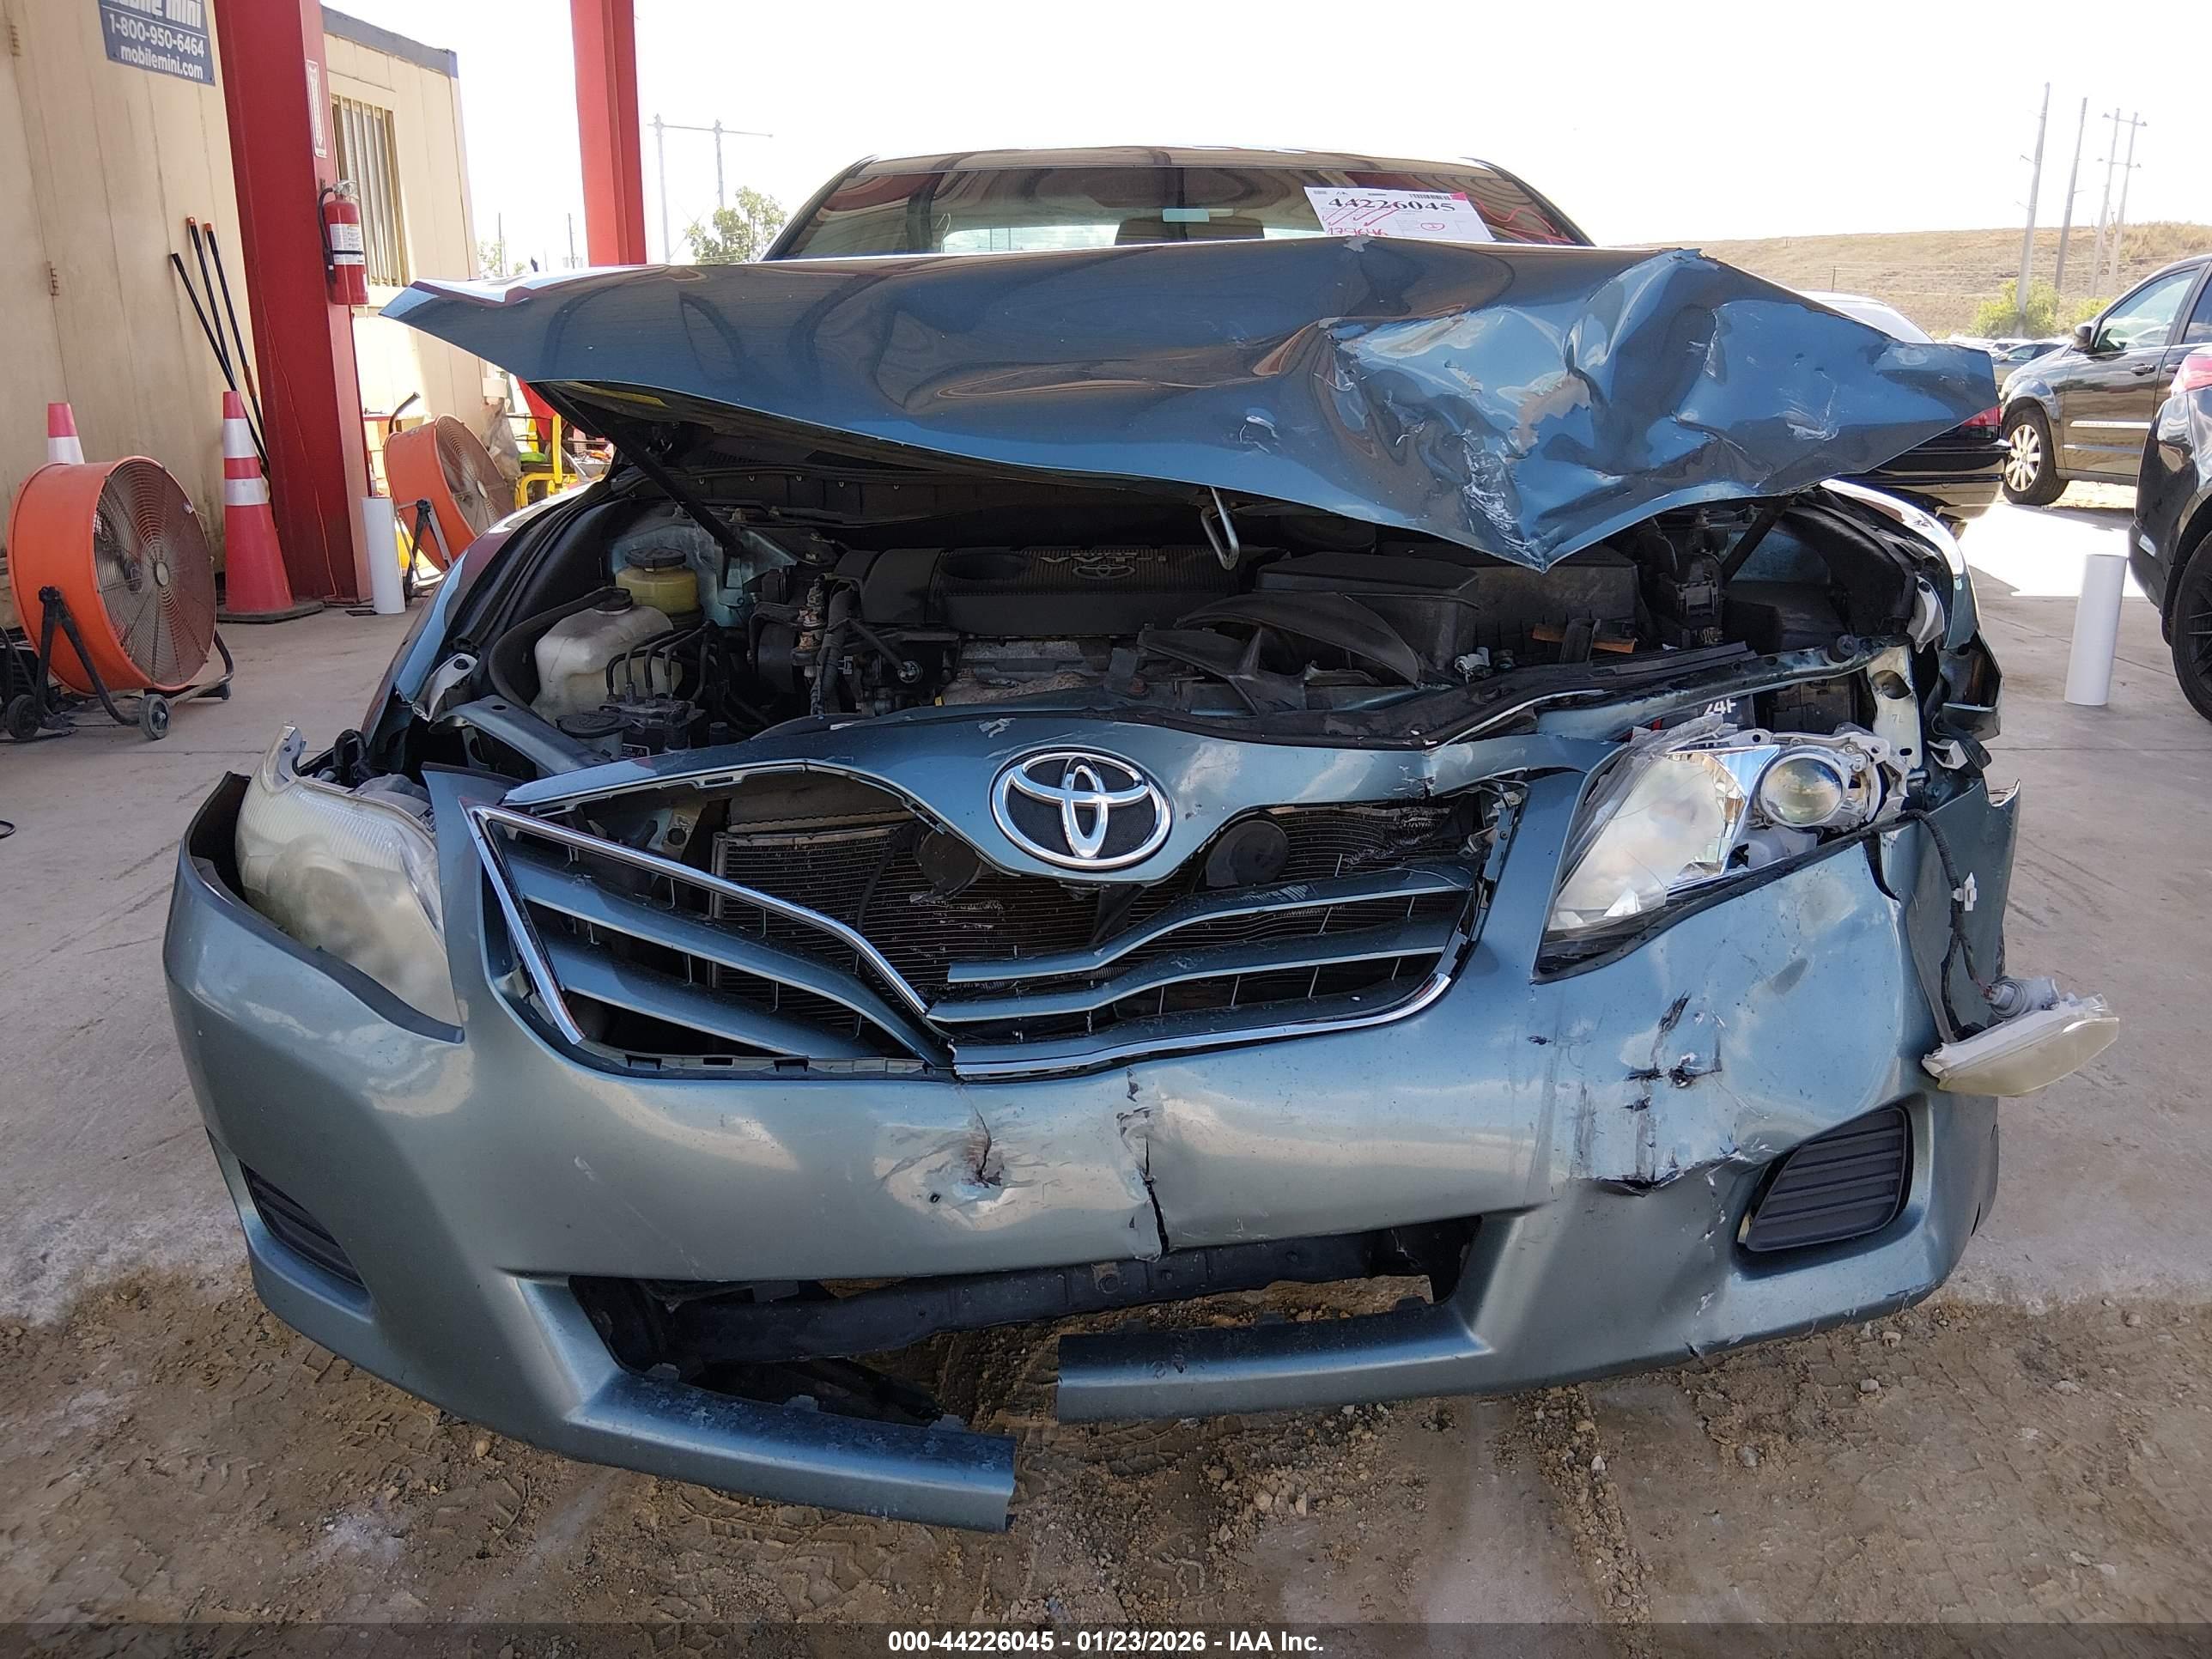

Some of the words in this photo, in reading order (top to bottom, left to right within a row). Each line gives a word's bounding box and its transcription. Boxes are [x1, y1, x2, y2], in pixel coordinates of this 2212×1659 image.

[109, 14, 205, 58] 1-800-950-6464
[120, 46, 204, 80] mobilemini.com
[1328, 198, 1455, 212] 44226045
